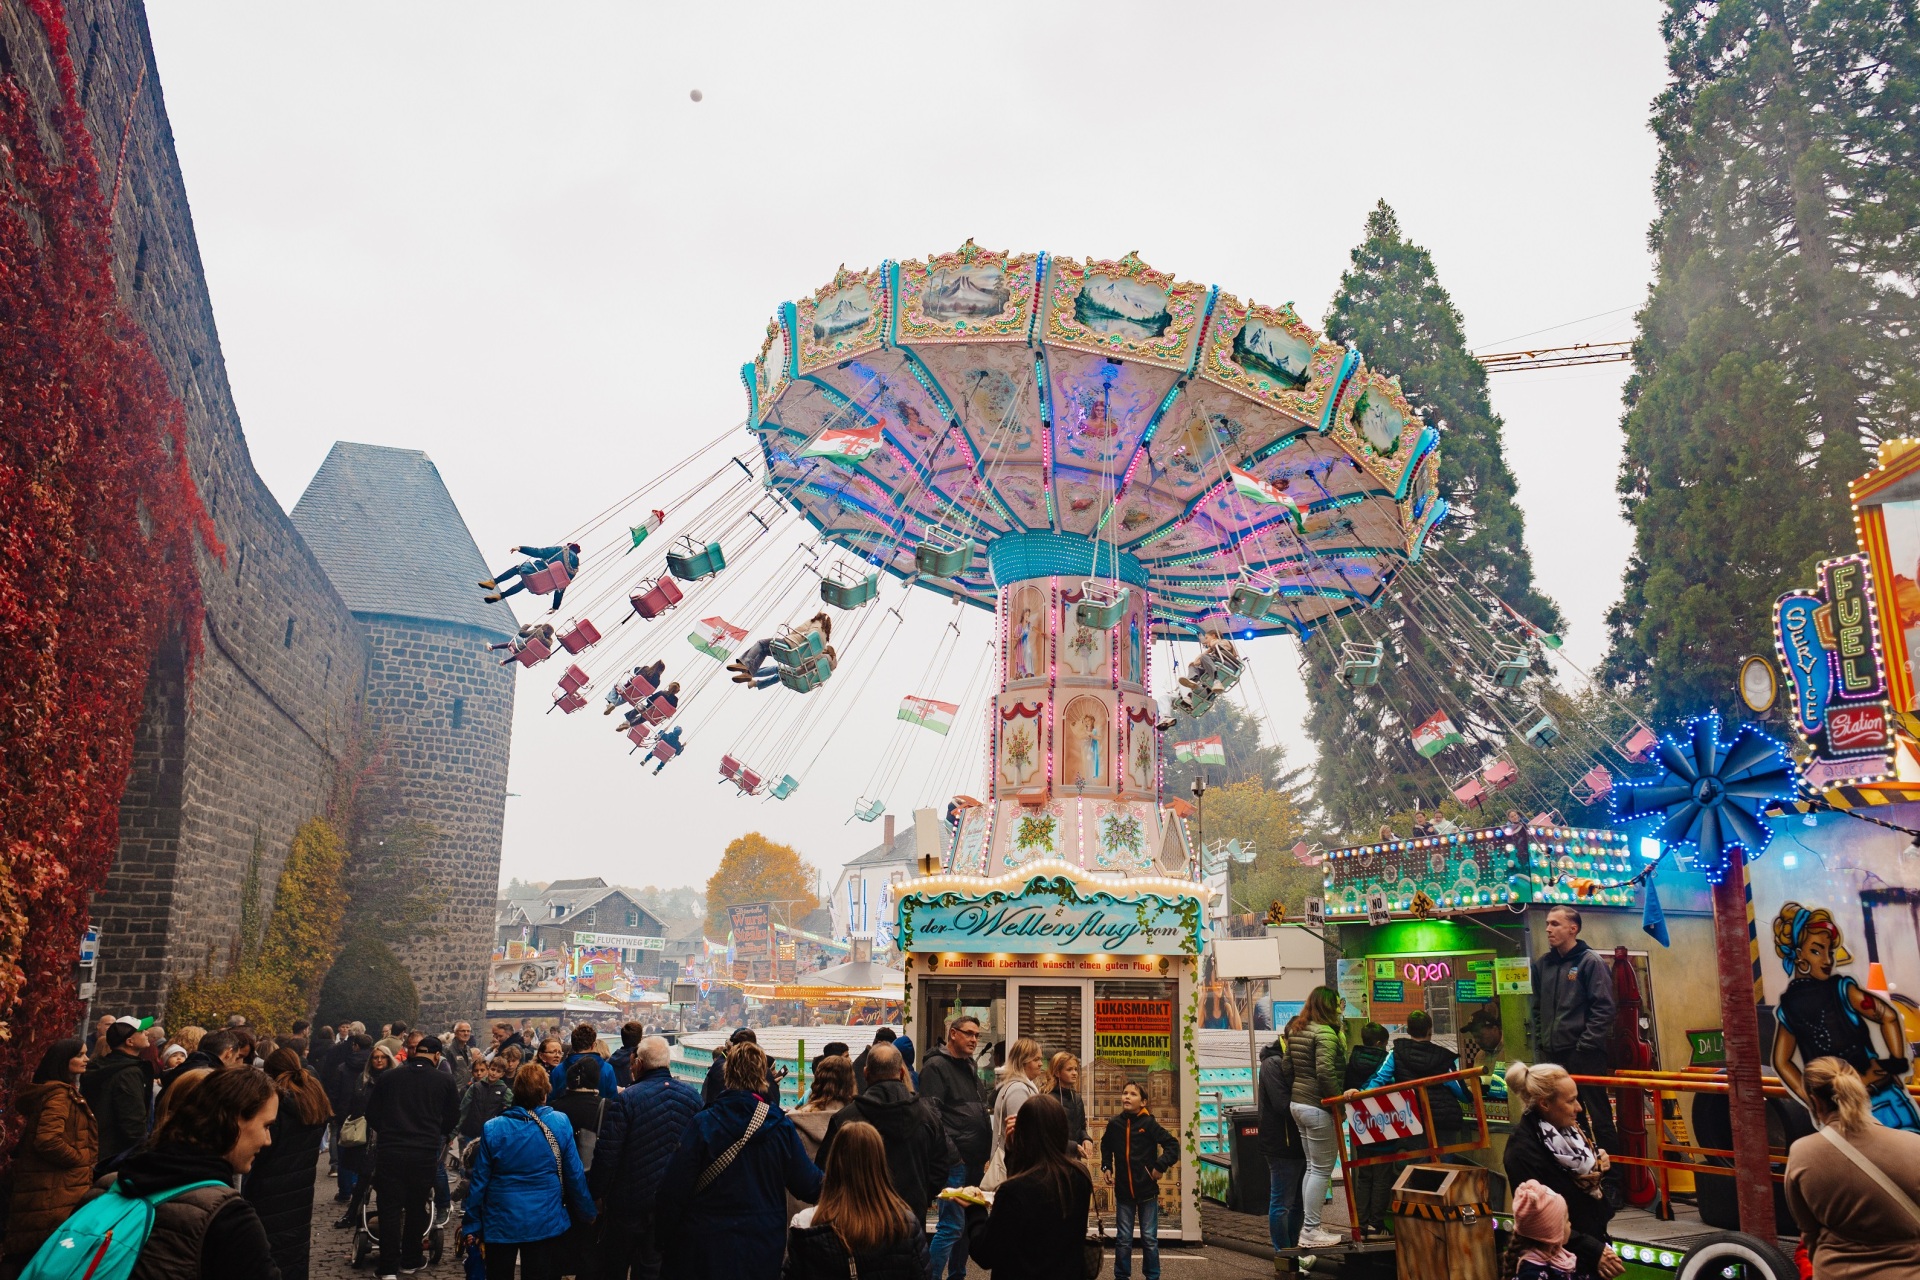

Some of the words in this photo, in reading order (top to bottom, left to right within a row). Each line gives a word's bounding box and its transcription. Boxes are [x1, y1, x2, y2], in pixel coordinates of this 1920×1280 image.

[1833, 564, 1871, 690] FUEL
[1786, 607, 1818, 722] SERVICE
[1831, 711, 1883, 741] Station
[1823, 763, 1865, 777] QUIET
[1310, 902, 1320, 912] NO
[1372, 898, 1383, 909] NO
[731, 912, 767, 926] Wurst
[597, 936, 643, 946] FLUCHTWEG
[944, 959, 973, 968] Familie
[977, 959, 995, 968] Rudi
[999, 960, 1039, 969] Eberhardt
[1043, 960, 1075, 969] wünscht
[1080, 961, 1101, 969] einen
[1106, 961, 1129, 971] guten
[1133, 961, 1153, 972] Flug!
[1096, 1003, 1170, 1015] LUKASMARKT
[1096, 1035, 1169, 1048] LUKASMARKT
[1698, 1039, 1712, 1054] DA
[1096, 1049, 1132, 1057] Donnerstag
[1352, 1100, 1414, 1135] Eingang!
